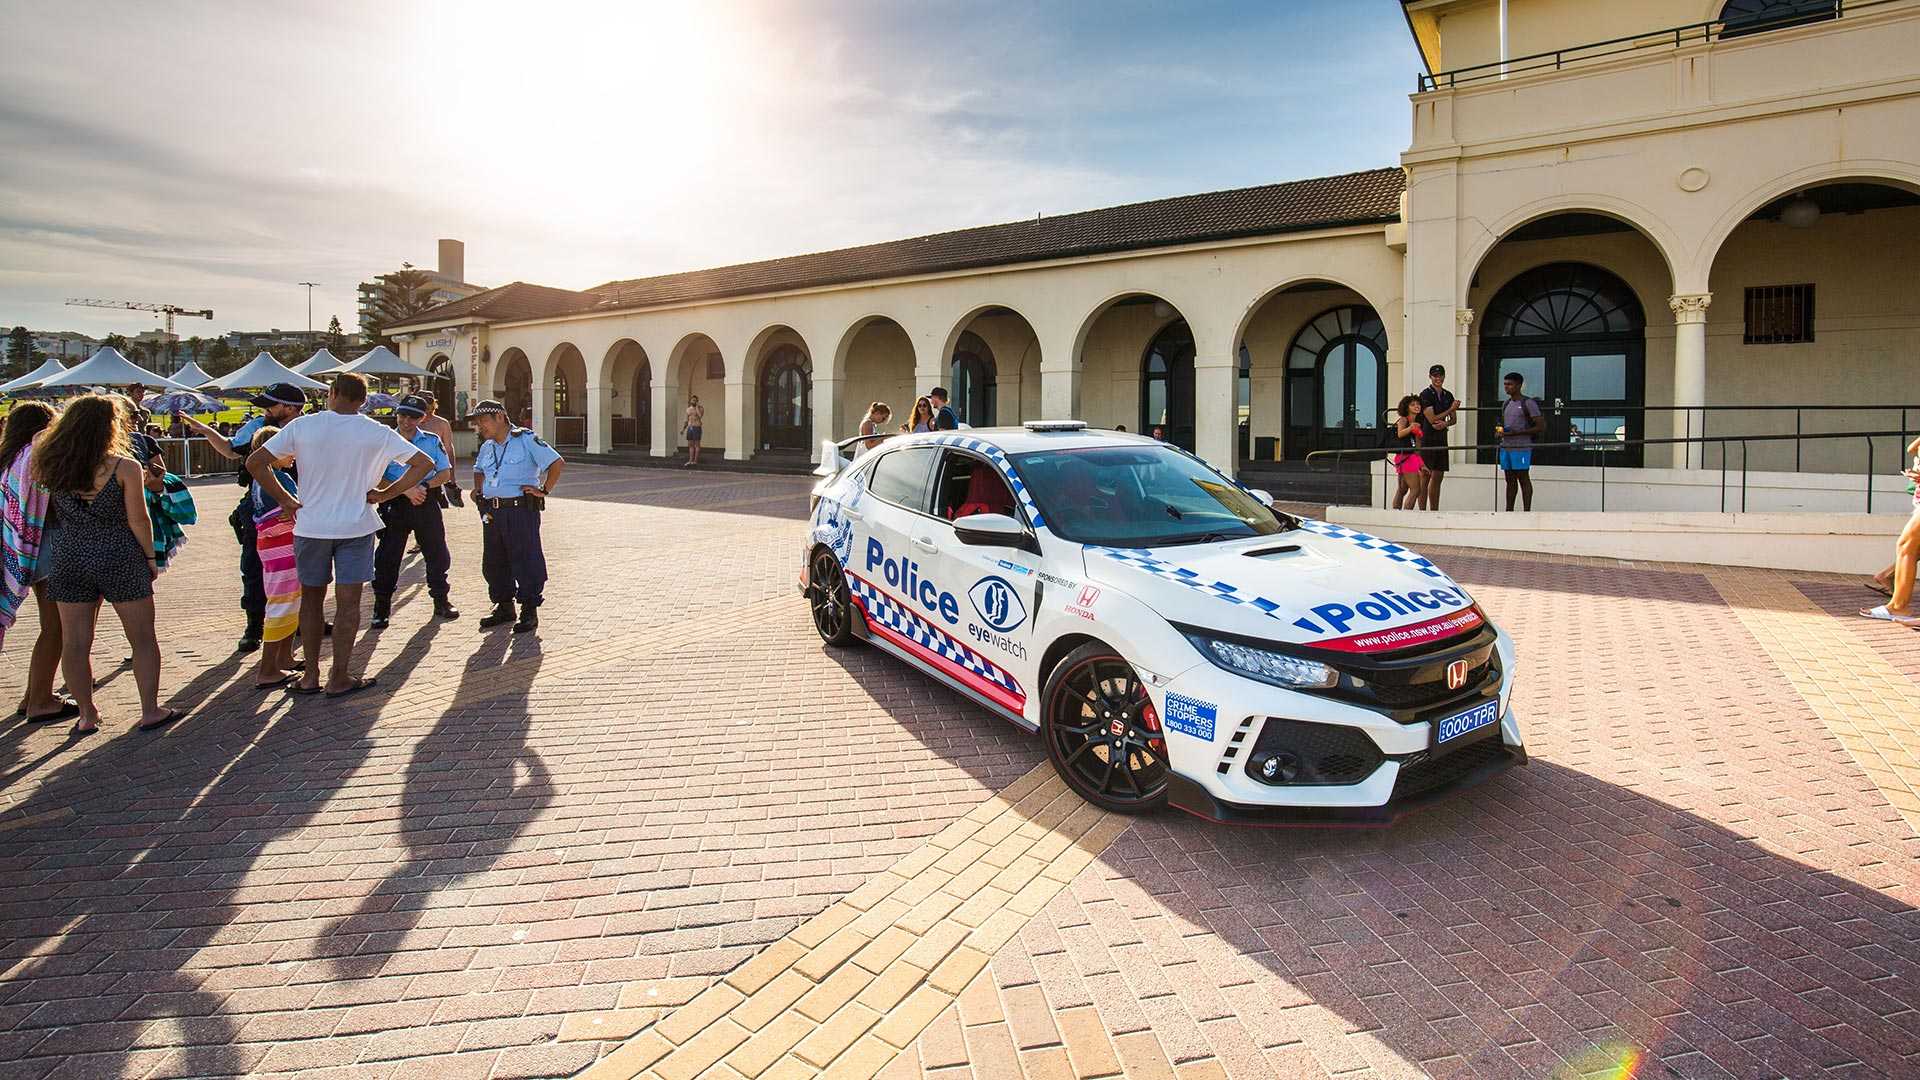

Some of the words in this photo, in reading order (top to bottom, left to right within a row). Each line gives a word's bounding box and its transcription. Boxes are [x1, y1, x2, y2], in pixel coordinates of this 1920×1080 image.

[866, 536, 959, 624] Police
[1064, 604, 1095, 621] HONDA
[1310, 589, 1462, 633] Police
[968, 623, 1027, 661] eyewatch
[1166, 707, 1213, 728] STOPPERS
[1167, 699, 1198, 716] CRIME
[1166, 719, 1182, 730] 1800
[1183, 725, 1197, 734] 333
[1197, 729, 1212, 739] 000
